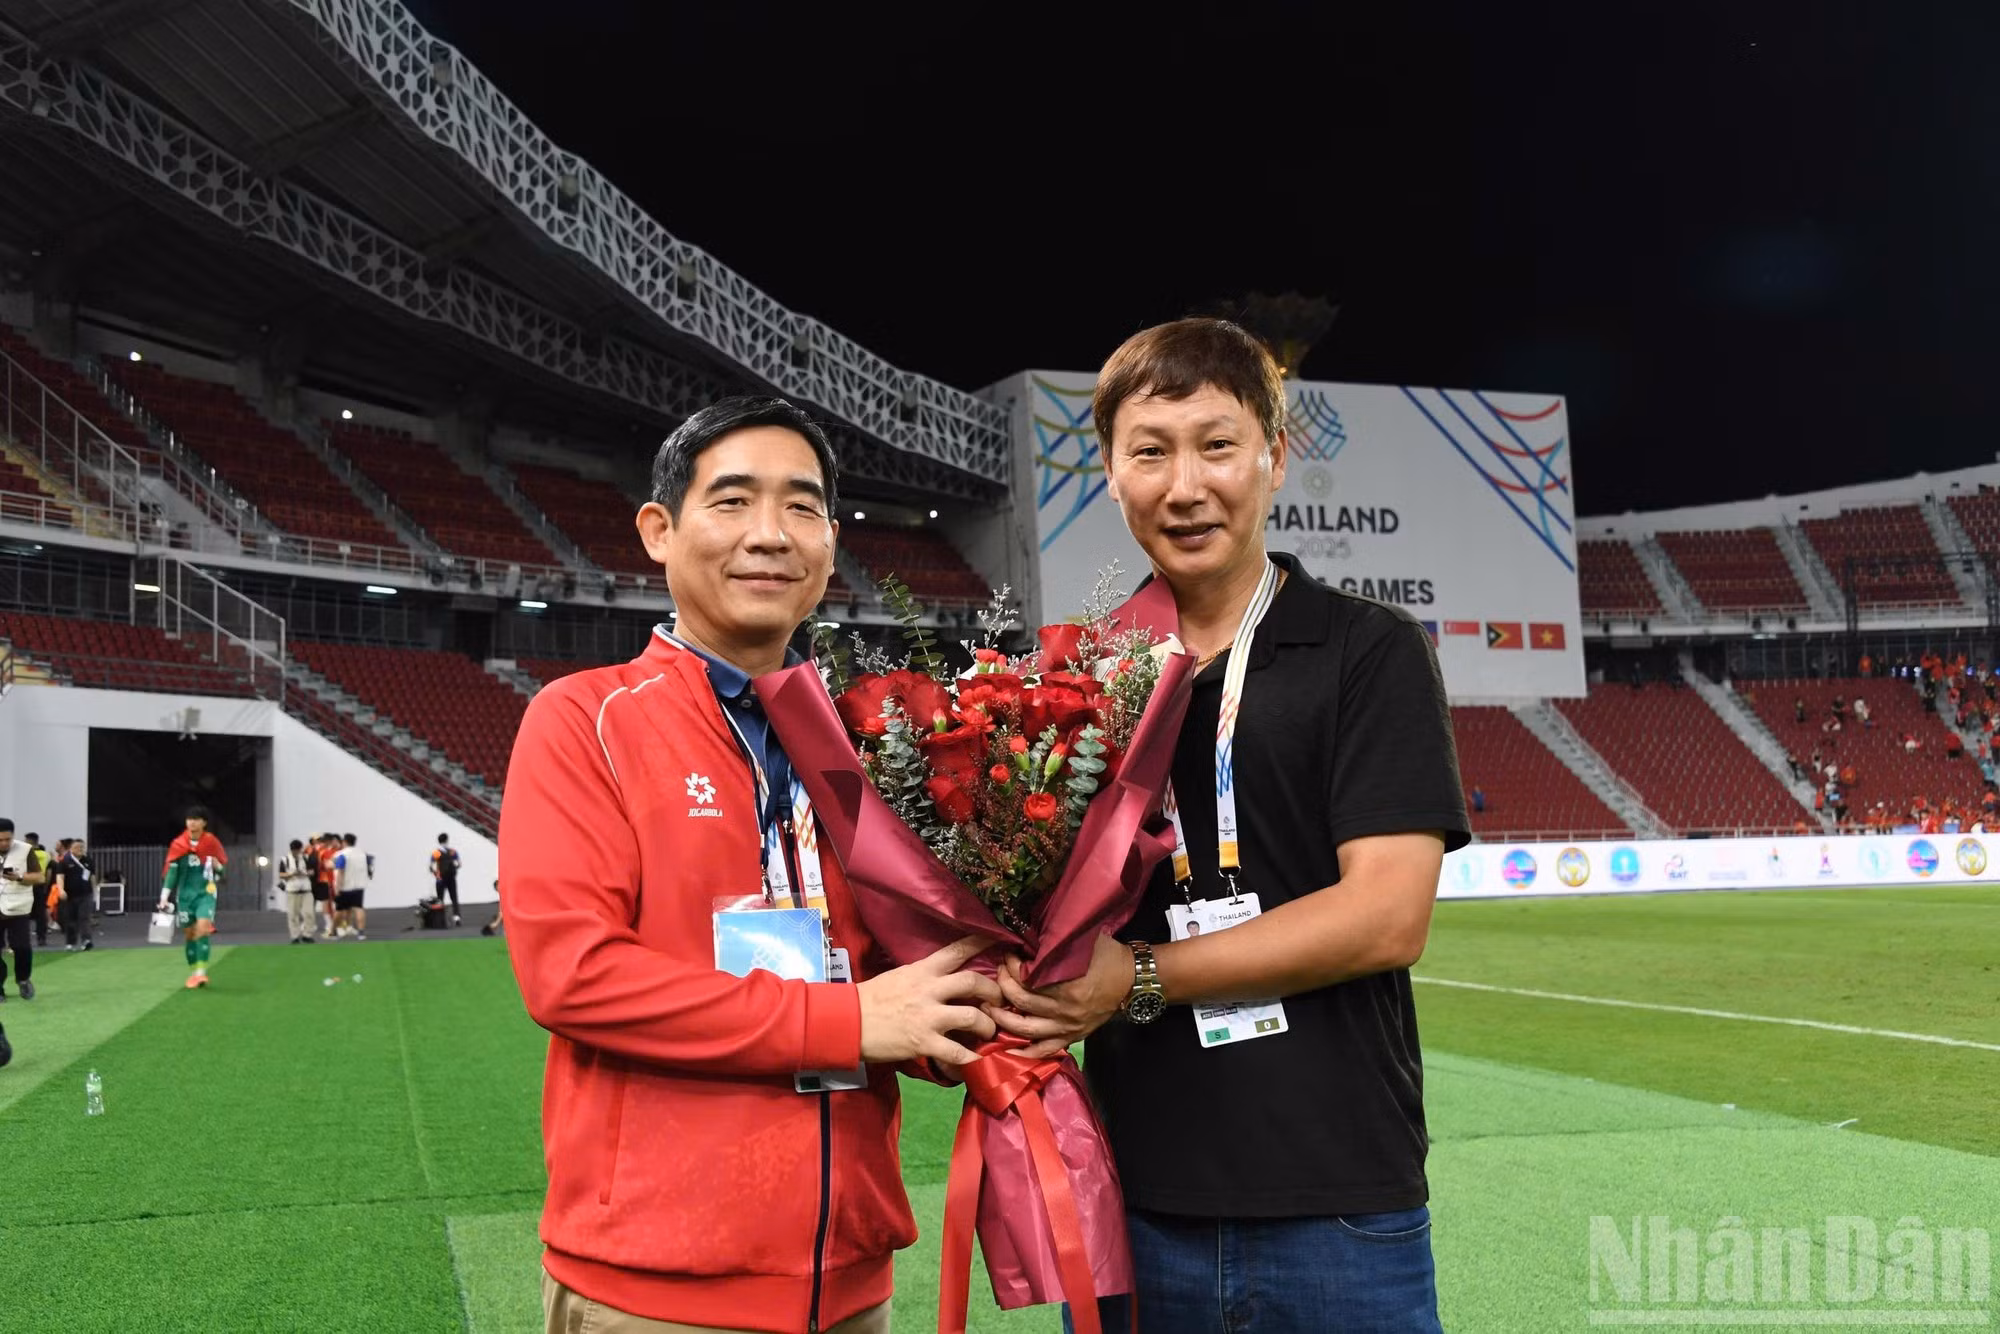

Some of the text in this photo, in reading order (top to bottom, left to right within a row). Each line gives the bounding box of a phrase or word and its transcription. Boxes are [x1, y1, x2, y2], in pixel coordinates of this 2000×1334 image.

[1265, 504, 1399, 534] HAILAND
[1294, 536, 1351, 559] 2025
[1340, 576, 1434, 605] GAMES
[1218, 910, 1252, 922] THAILAND
[1214, 1031, 1222, 1040] S
